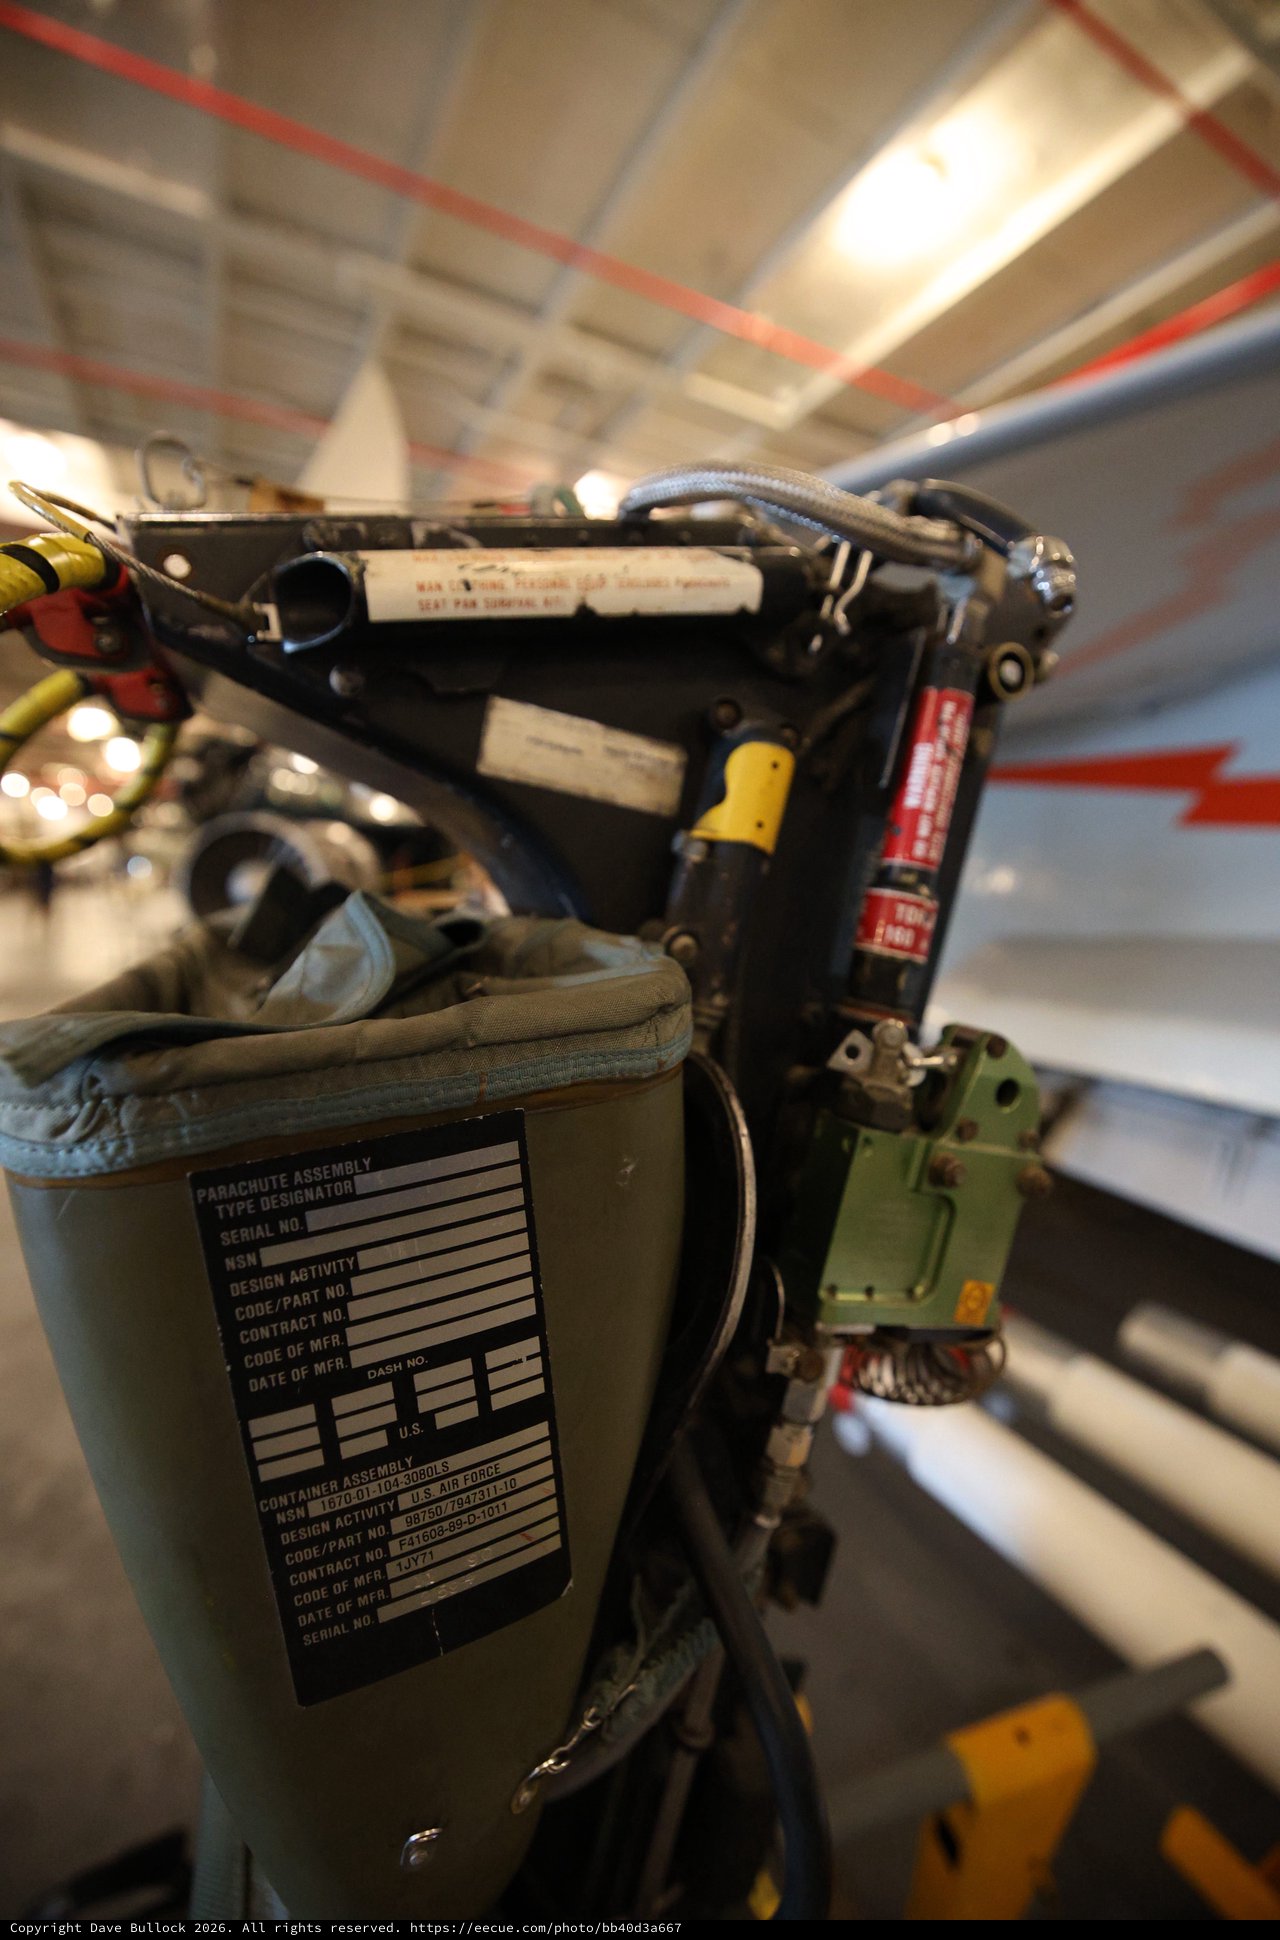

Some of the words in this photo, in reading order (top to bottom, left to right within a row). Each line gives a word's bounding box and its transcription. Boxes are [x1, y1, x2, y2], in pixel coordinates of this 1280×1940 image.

[196, 1173, 289, 1204] PARACHUTE
[294, 1157, 372, 1185] ASSEMBLY
[215, 1199, 256, 1220] TYPE
[261, 1180, 354, 1212] DESIGNATOR
[220, 1223, 274, 1246] SERIAL
[279, 1217, 304, 1234] NO.
[224, 1252, 257, 1272] NSN
[229, 1273, 284, 1297] DESIGN
[290, 1256, 356, 1284] ACTIVITY
[234, 1289, 320, 1321] CODE/PART
[325, 1283, 349, 1300] NO.
[239, 1313, 318, 1344] CONTRACT
[322, 1308, 346, 1325] NO.
[244, 1349, 283, 1369] CODE
[287, 1343, 304, 1359] OF
[309, 1334, 344, 1353] MFR.
[367, 1363, 403, 1380] DASH
[407, 1356, 429, 1368] NO.
[249, 1373, 287, 1392] DATE
[291, 1367, 309, 1382] OF
[314, 1356, 348, 1376] MFR.
[399, 1422, 425, 1439] U.S.
[259, 1480, 338, 1512] CONTAINER
[343, 1456, 414, 1488] ASSEMBLY
[276, 1506, 306, 1525] NSN
[321, 1461, 449, 1511] 1670-01-104-3080LS
[280, 1520, 331, 1545] DESIGN
[336, 1500, 395, 1530] ACTIVITY
[412, 1488, 436, 1504] U.S.
[440, 1478, 460, 1495] AIR
[463, 1463, 501, 1486] FORCE
[285, 1532, 363, 1566] CODE/PART
[367, 1525, 390, 1541] NO.
[405, 1477, 517, 1527] 98750/7947311-10
[289, 1555, 361, 1586] CONTRACT
[365, 1547, 388, 1564] NO.
[398, 1502, 508, 1550] F41608-89-D-1011
[293, 1586, 329, 1607] CODE
[332, 1579, 350, 1596] OF
[354, 1569, 386, 1588] MFR.
[396, 1551, 434, 1572] 1JY71
[297, 1607, 333, 1627] DATE
[336, 1600, 353, 1615] OF
[357, 1589, 389, 1608] MFR.
[302, 1623, 349, 1646] SERIAL
[353, 1614, 375, 1630] NO.
